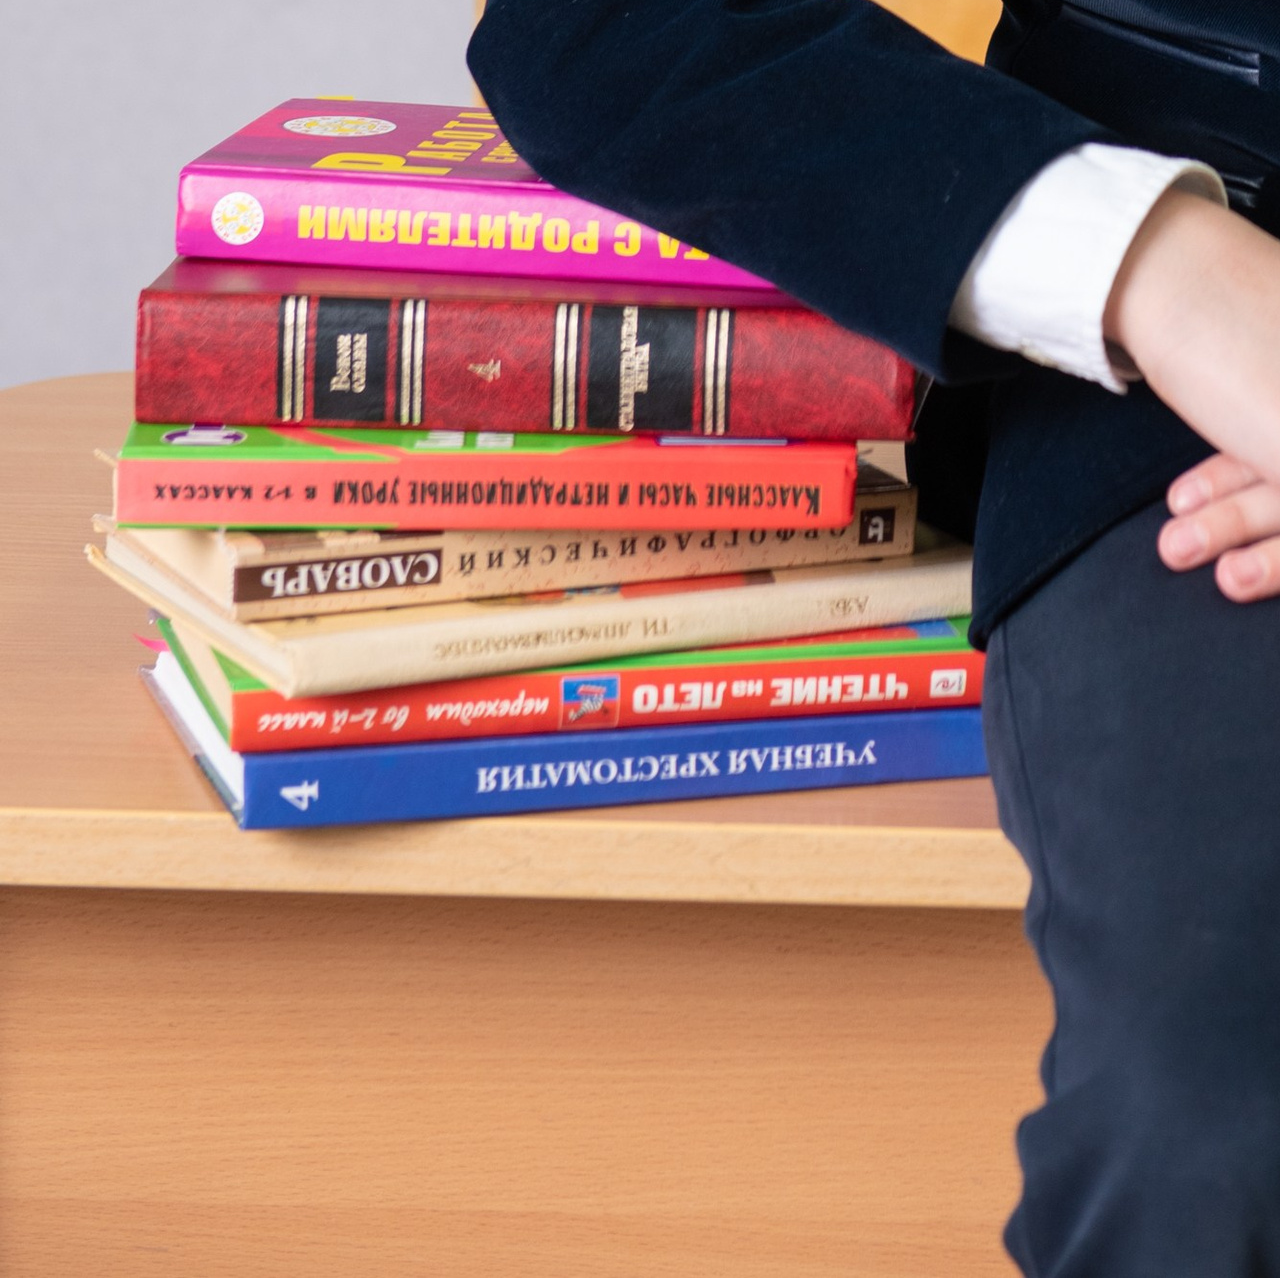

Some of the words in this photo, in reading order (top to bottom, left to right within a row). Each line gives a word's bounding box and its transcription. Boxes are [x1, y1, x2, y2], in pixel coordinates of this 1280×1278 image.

[297, 204, 600, 254] РОДИТЕЛЯМИ
[612, 221, 642, 257] С
[153, 483, 254, 501] КЛАССАХ
[332, 476, 400, 505] УРОКИ
[408, 476, 611, 507] НЕТРАДИЦИОННЫЕ
[617, 483, 631, 506] И
[638, 482, 698, 507] ЧАСЫ
[705, 483, 822, 516] КЛАССНЫЕ
[260, 552, 440, 598] СЛОВАРЬ
[631, 680, 728, 714] ЛЕТО
[769, 672, 909, 708] ЧТЕНИЕ
[256, 708, 326, 733] класс
[331, 708, 376, 734] 2-й
[380, 704, 410, 732] во
[425, 690, 550, 726] переходим
[475, 750, 721, 794] ХРЕСТОМАТИЯ
[727, 739, 878, 775] УЧЕБНАЯ
[279, 778, 320, 811] 4
